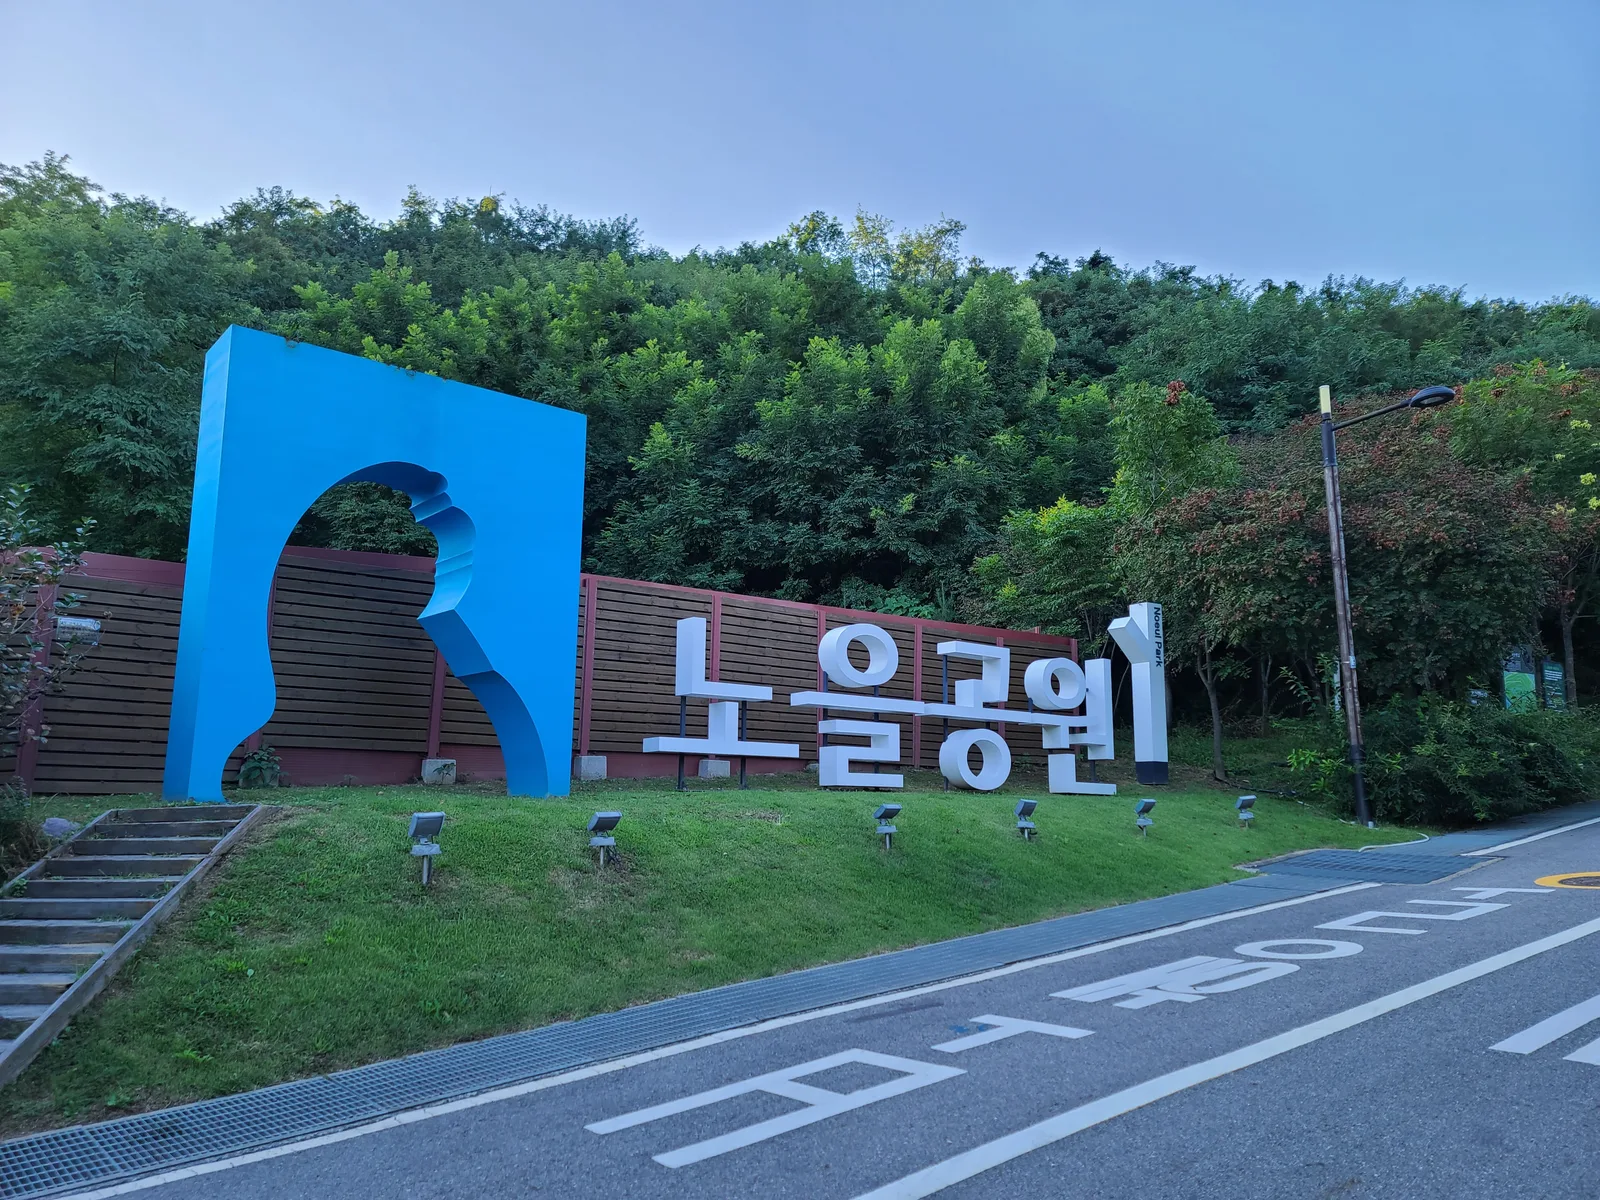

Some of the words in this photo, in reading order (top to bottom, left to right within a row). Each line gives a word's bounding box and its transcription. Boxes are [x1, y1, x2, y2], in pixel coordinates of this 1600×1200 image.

[1153, 606, 1162, 639] Noeul
[1155, 641, 1163, 668] Park
[643, 616, 1117, 795] 노을공원
